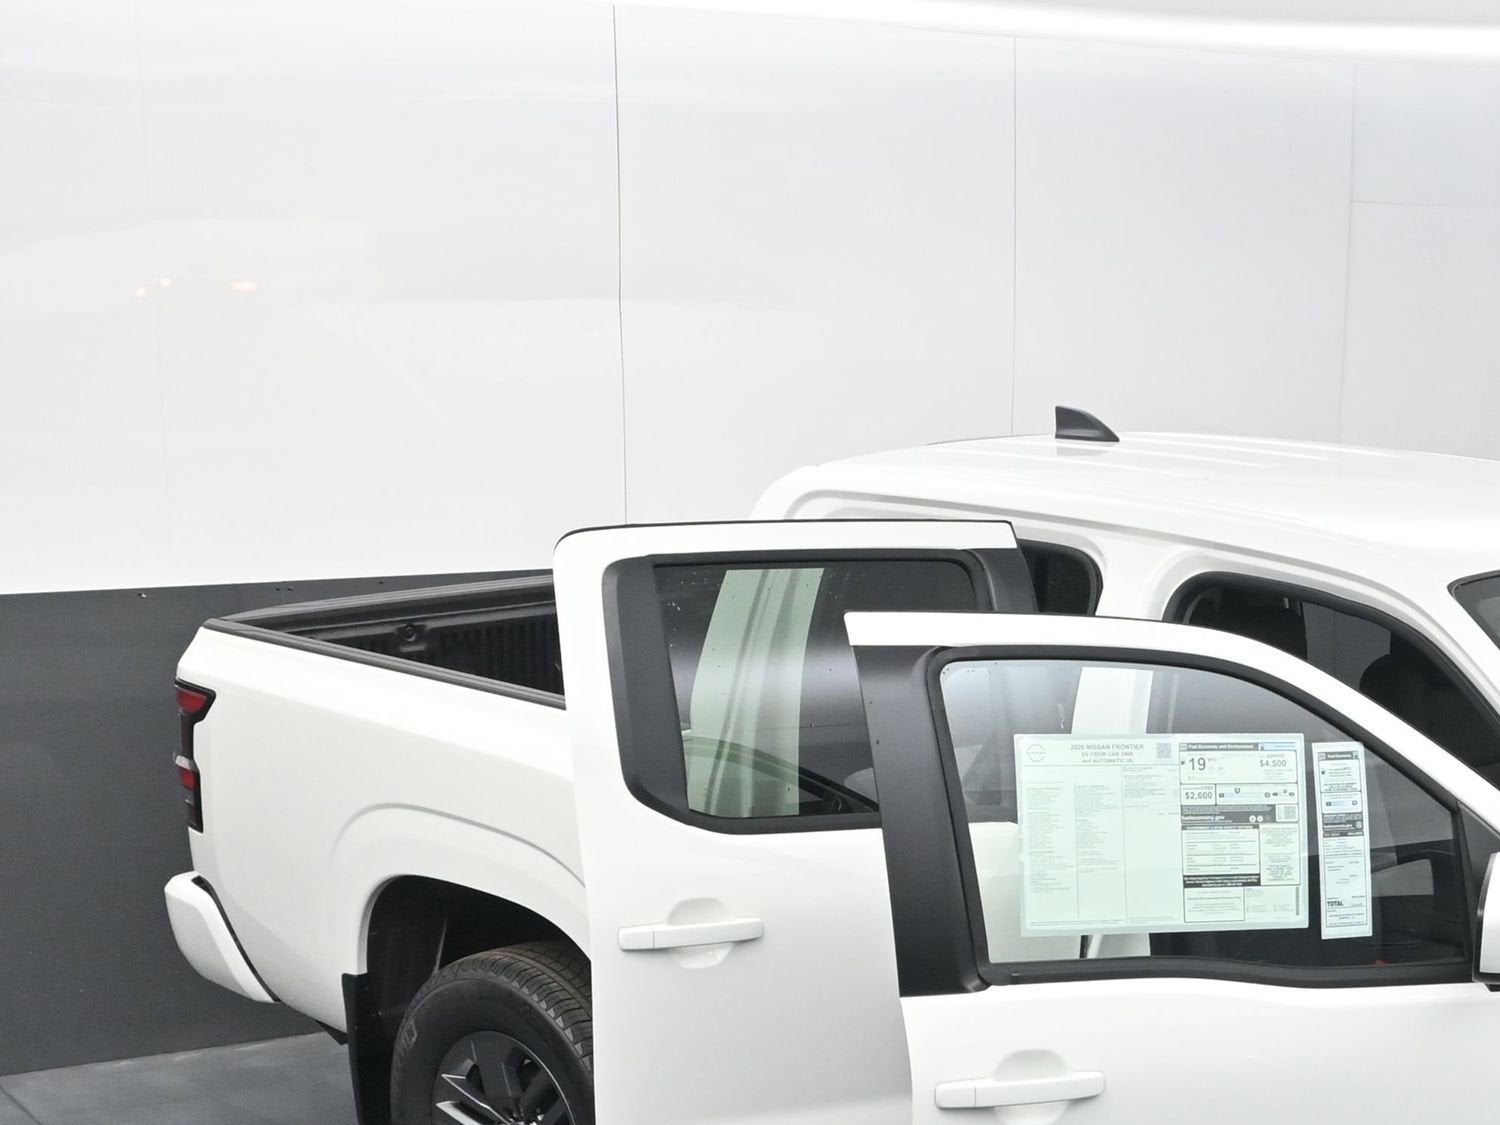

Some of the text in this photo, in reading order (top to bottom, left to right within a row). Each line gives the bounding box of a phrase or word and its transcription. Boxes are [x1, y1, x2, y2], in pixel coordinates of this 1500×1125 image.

[1086, 743, 1110, 751] NISSAN
[1189, 757, 1206, 771] 19
[1185, 791, 1212, 800] $2,600
